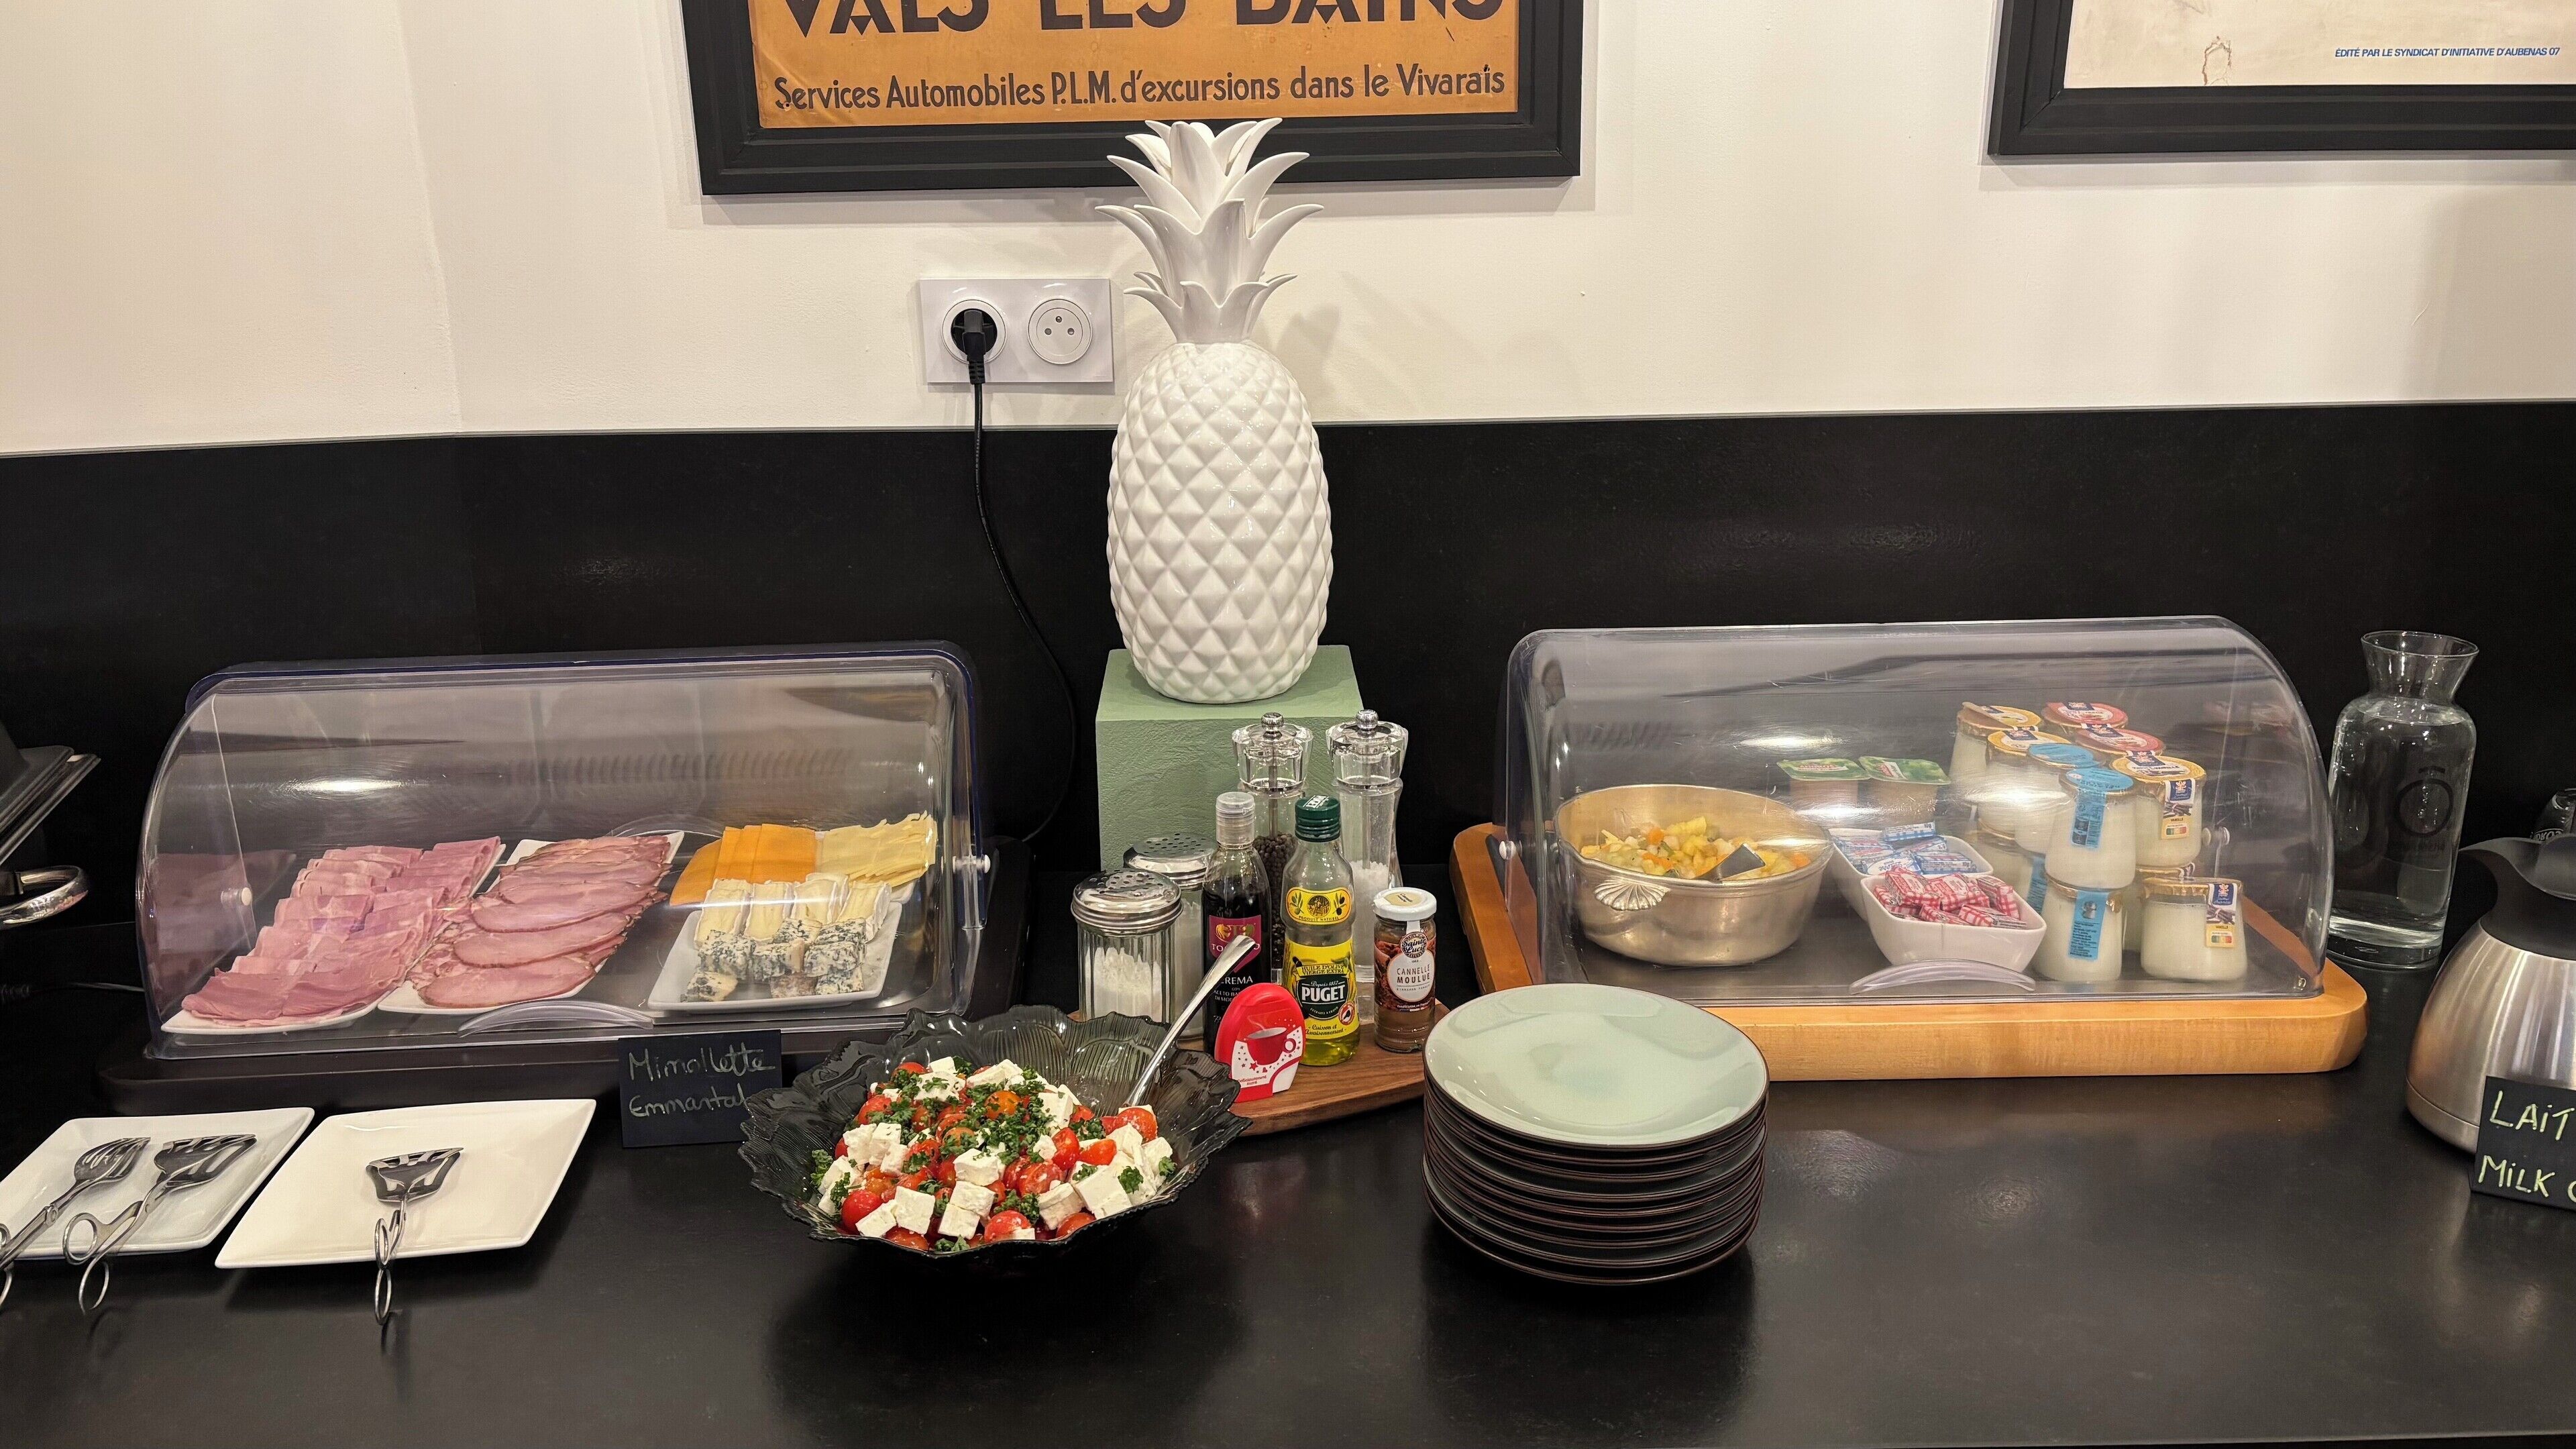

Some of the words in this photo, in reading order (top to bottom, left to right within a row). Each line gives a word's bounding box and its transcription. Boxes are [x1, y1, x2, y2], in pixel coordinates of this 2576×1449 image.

[2335, 48, 2360, 57] ÉDITÉ
[2362, 48, 2380, 56] PAR
[2382, 48, 2393, 56] LE
[2394, 48, 2440, 56] SYNDICAT
[2441, 48, 2495, 56] D'INITIATIVE
[2496, 48, 2547, 56] D'AUBENAS
[2549, 47, 2561, 55] 07
[775, 77, 880, 109] Services
[886, 73, 1044, 108] Automobiles
[1052, 70, 1117, 105] P.L.M.
[1120, 69, 1281, 103] d'excursions
[1290, 66, 1354, 99] dans
[1364, 64, 1389, 97] le
[1396, 964, 1430, 975] CANNELLE
[1221, 975, 1253, 985] REMA
[1397, 973, 1430, 983] MOULUE
[1301, 985, 1346, 1002] PUGET
